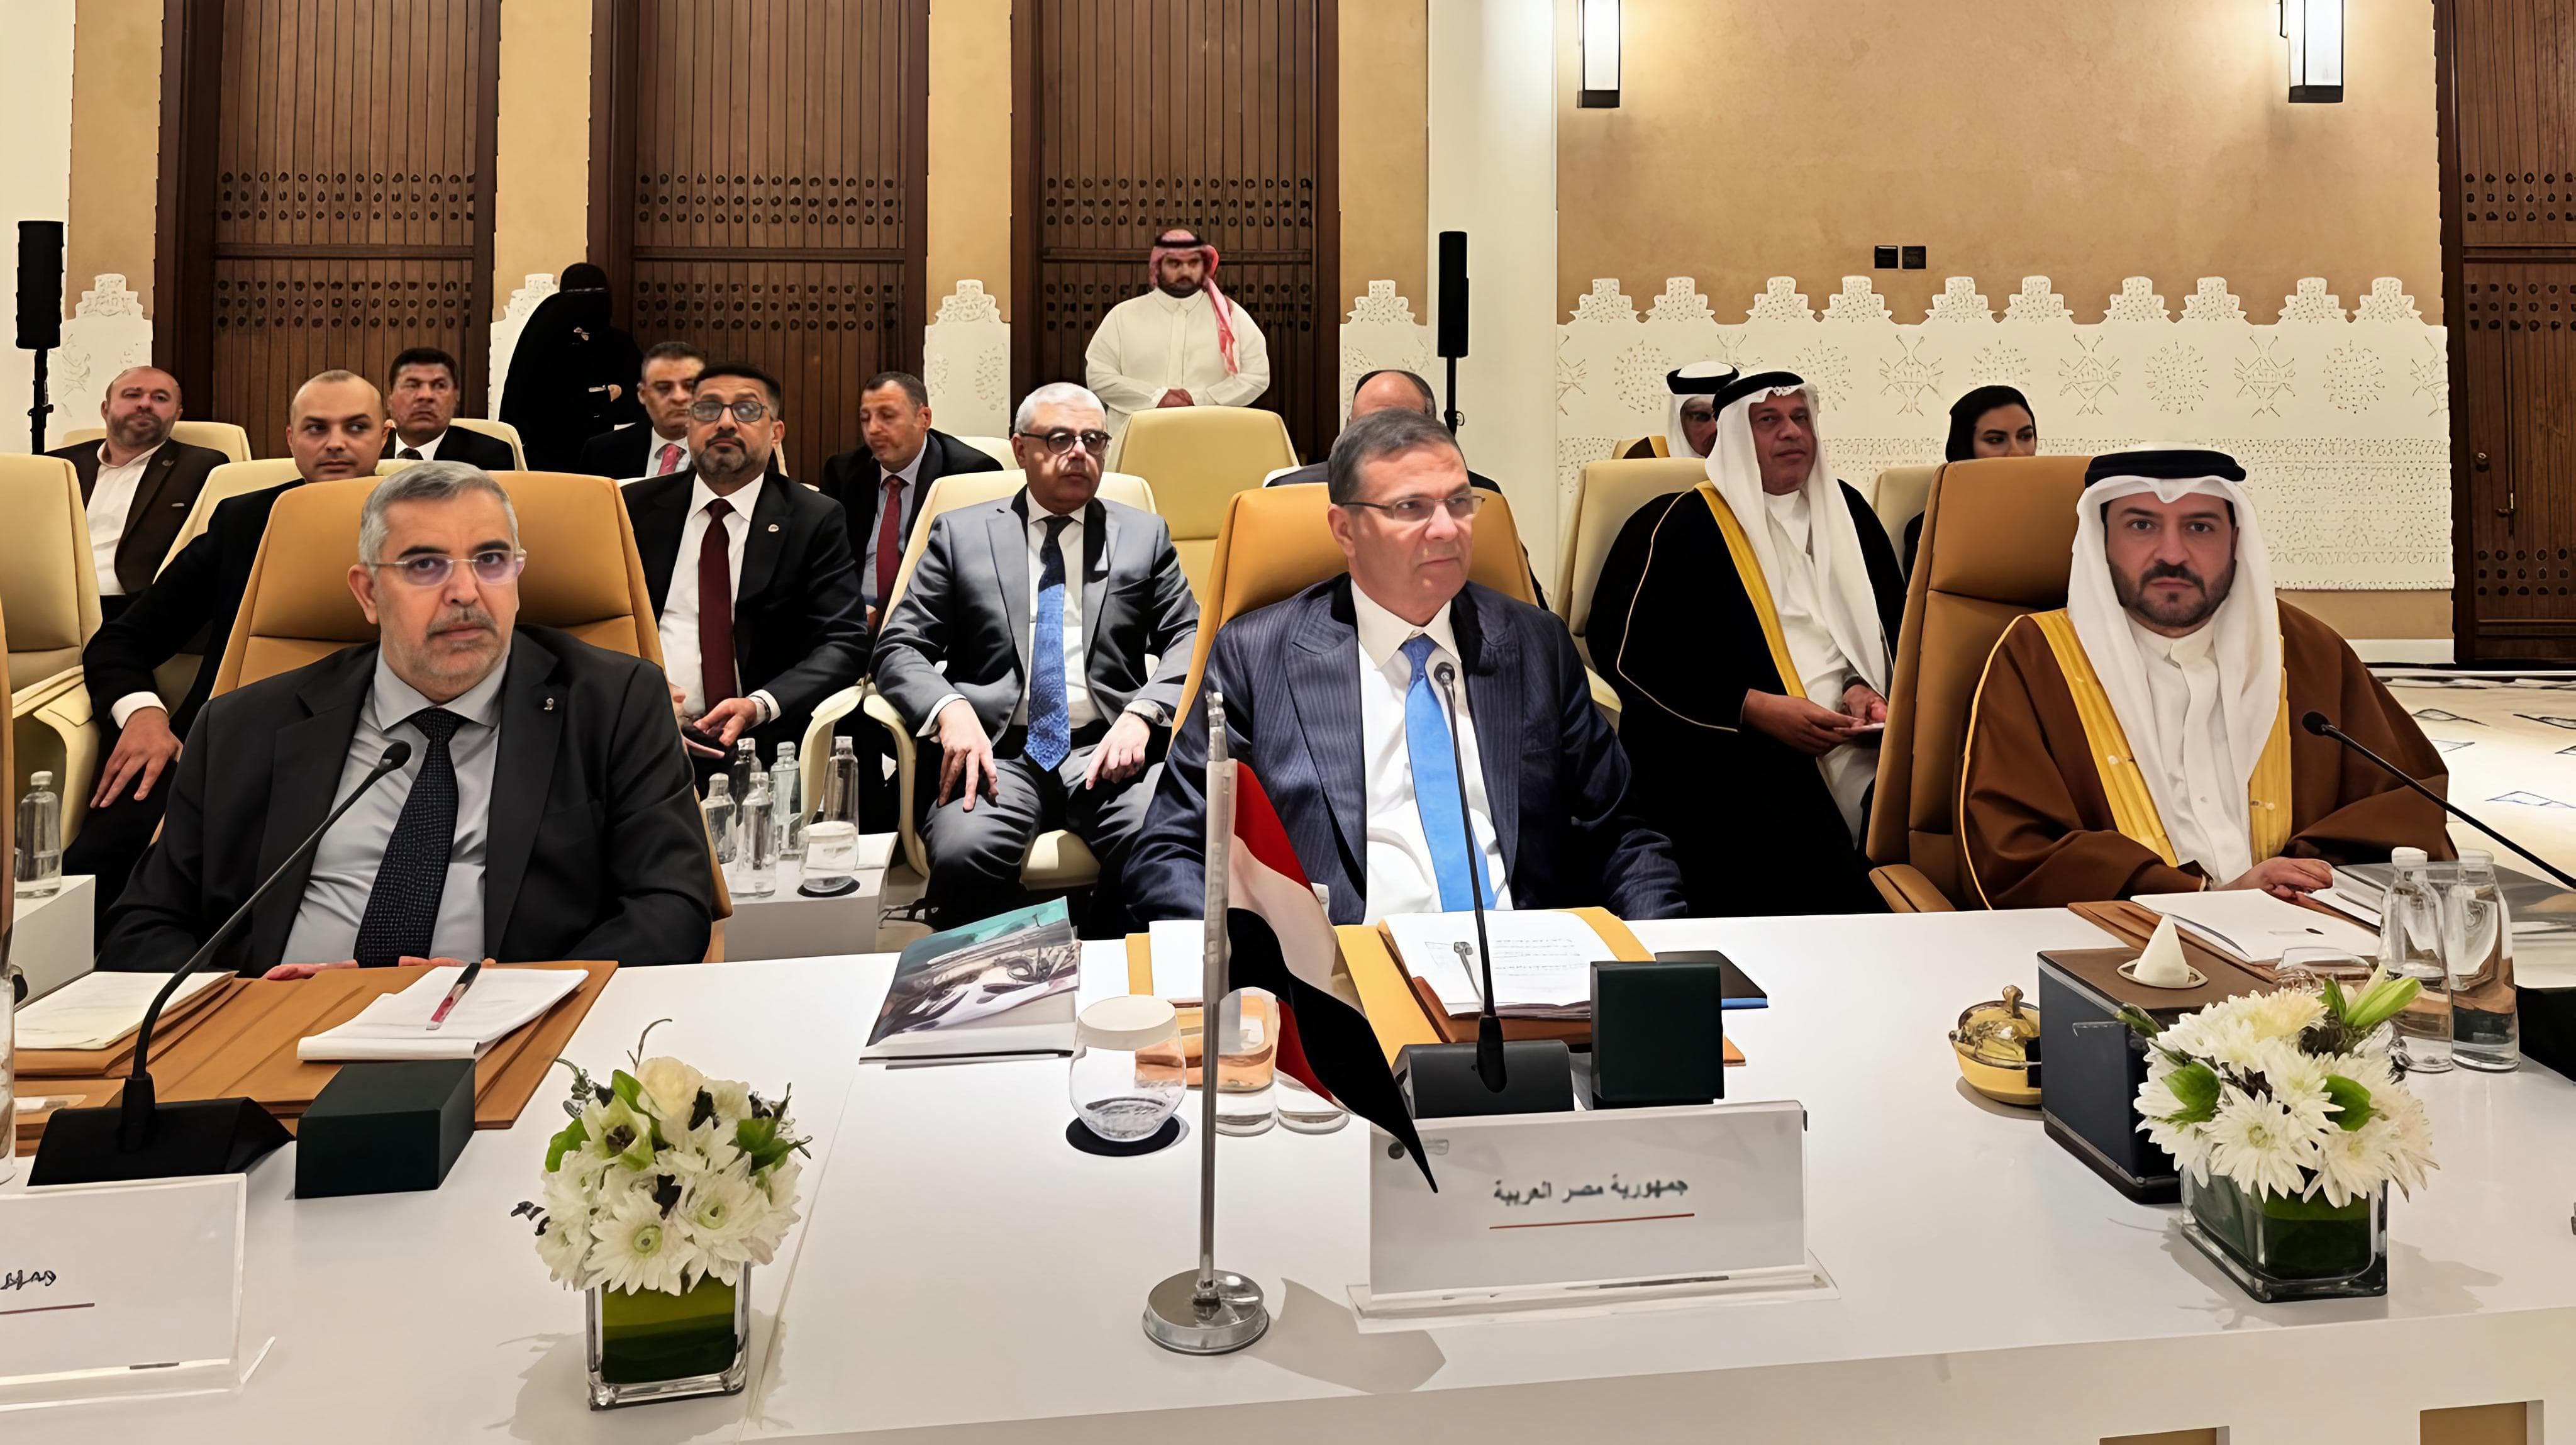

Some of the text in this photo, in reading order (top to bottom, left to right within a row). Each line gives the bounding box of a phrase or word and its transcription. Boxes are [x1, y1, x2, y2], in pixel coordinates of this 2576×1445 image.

[1493, 1173, 1689, 1207] جمهورية مصر العربية
